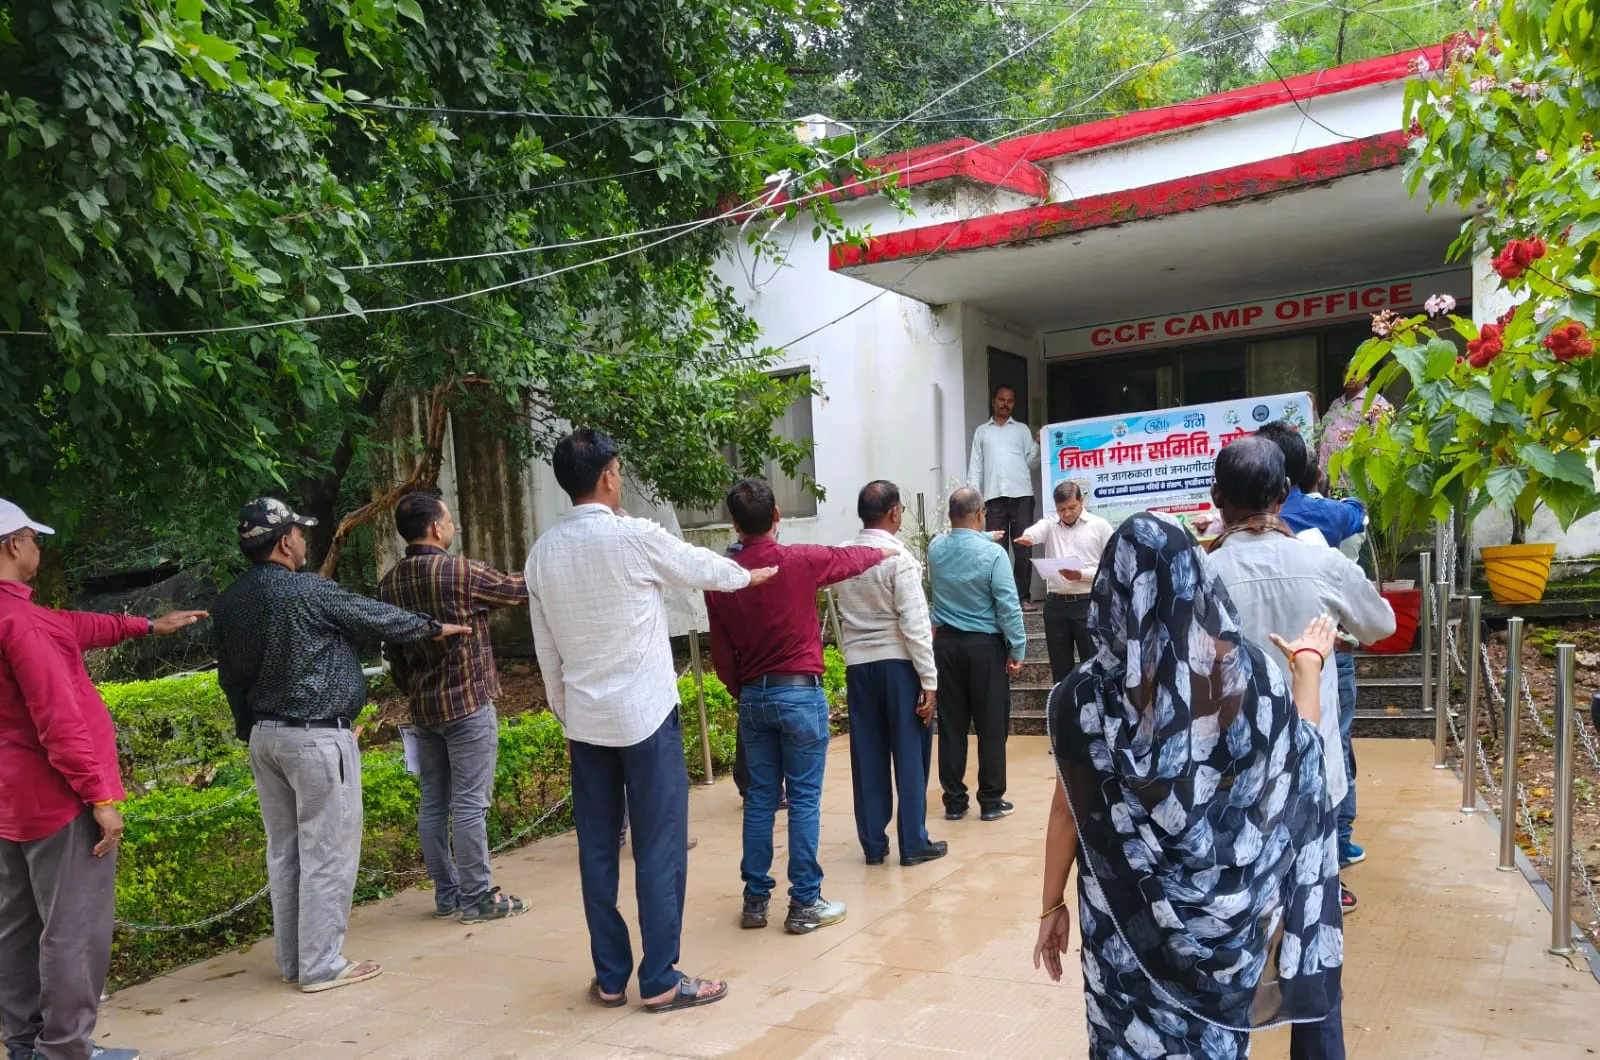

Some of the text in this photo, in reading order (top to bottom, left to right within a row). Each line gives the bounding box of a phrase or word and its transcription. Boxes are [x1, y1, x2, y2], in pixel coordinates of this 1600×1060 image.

[1164, 306, 1264, 338] CAMP
[1274, 282, 1414, 321] OFFICE
[1058, 446, 1105, 472] जिला
[1108, 440, 1143, 465] गंगा
[1147, 431, 1216, 461] समिति,
[1096, 473, 1109, 483] जन
[1154, 463, 1168, 476] एवं
